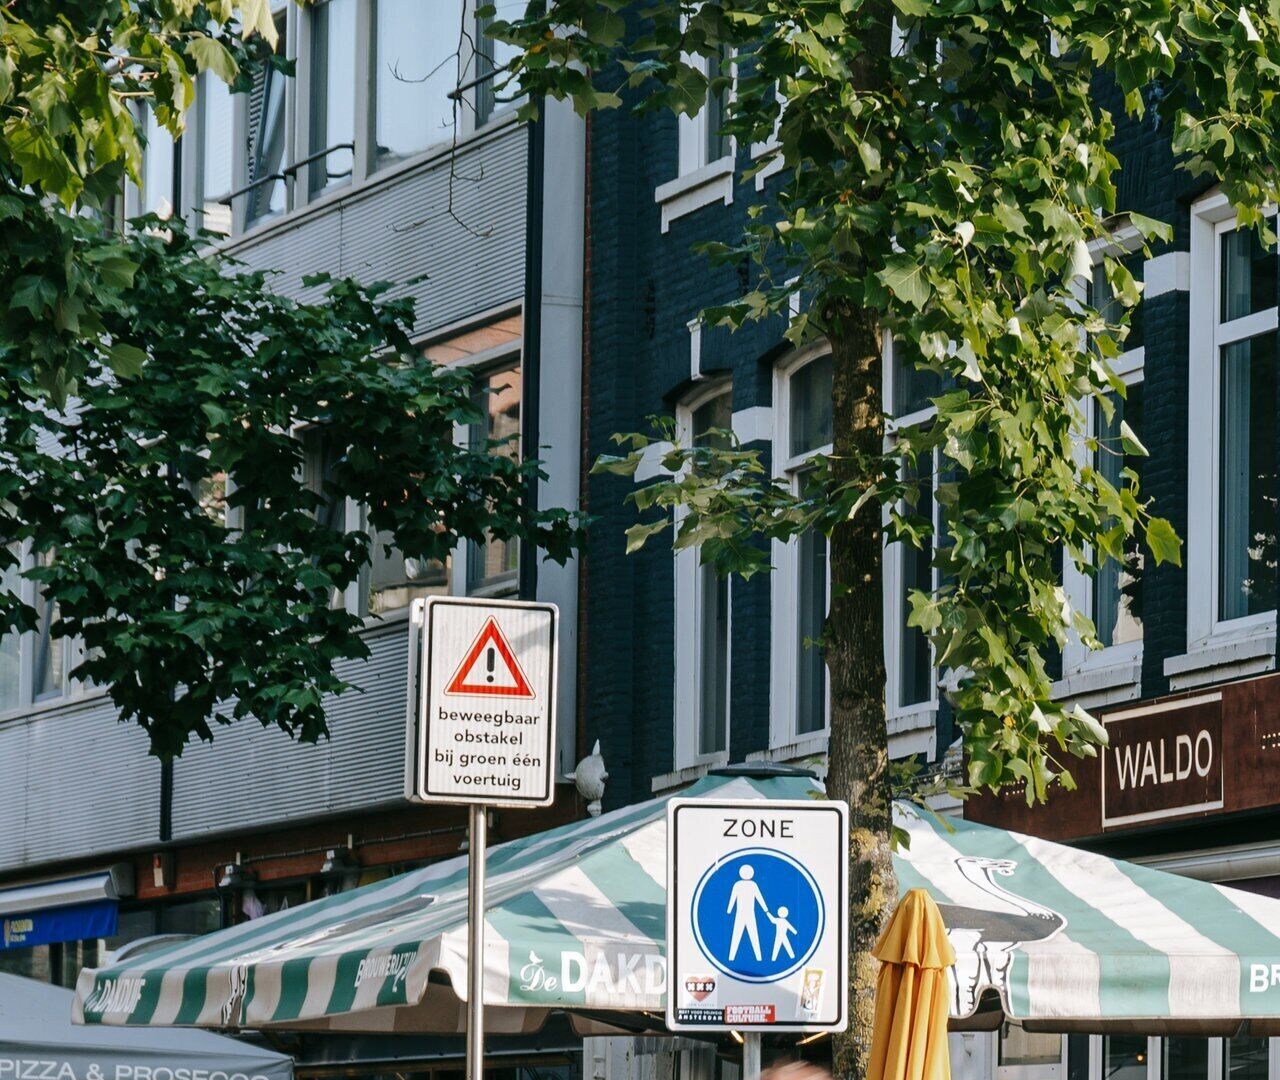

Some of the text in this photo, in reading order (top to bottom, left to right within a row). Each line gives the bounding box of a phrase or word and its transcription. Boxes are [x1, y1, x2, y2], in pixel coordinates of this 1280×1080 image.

[438, 707, 540, 727] beweegbaar
[454, 729, 523, 745] obstakel
[434, 749, 541, 768] bij groen één
[1115, 729, 1213, 790] WALDO
[453, 773, 521, 790] voertuig
[722, 818, 794, 838] ZONE
[520, 962, 558, 992] De
[92, 978, 146, 1014] DAKDUIF
